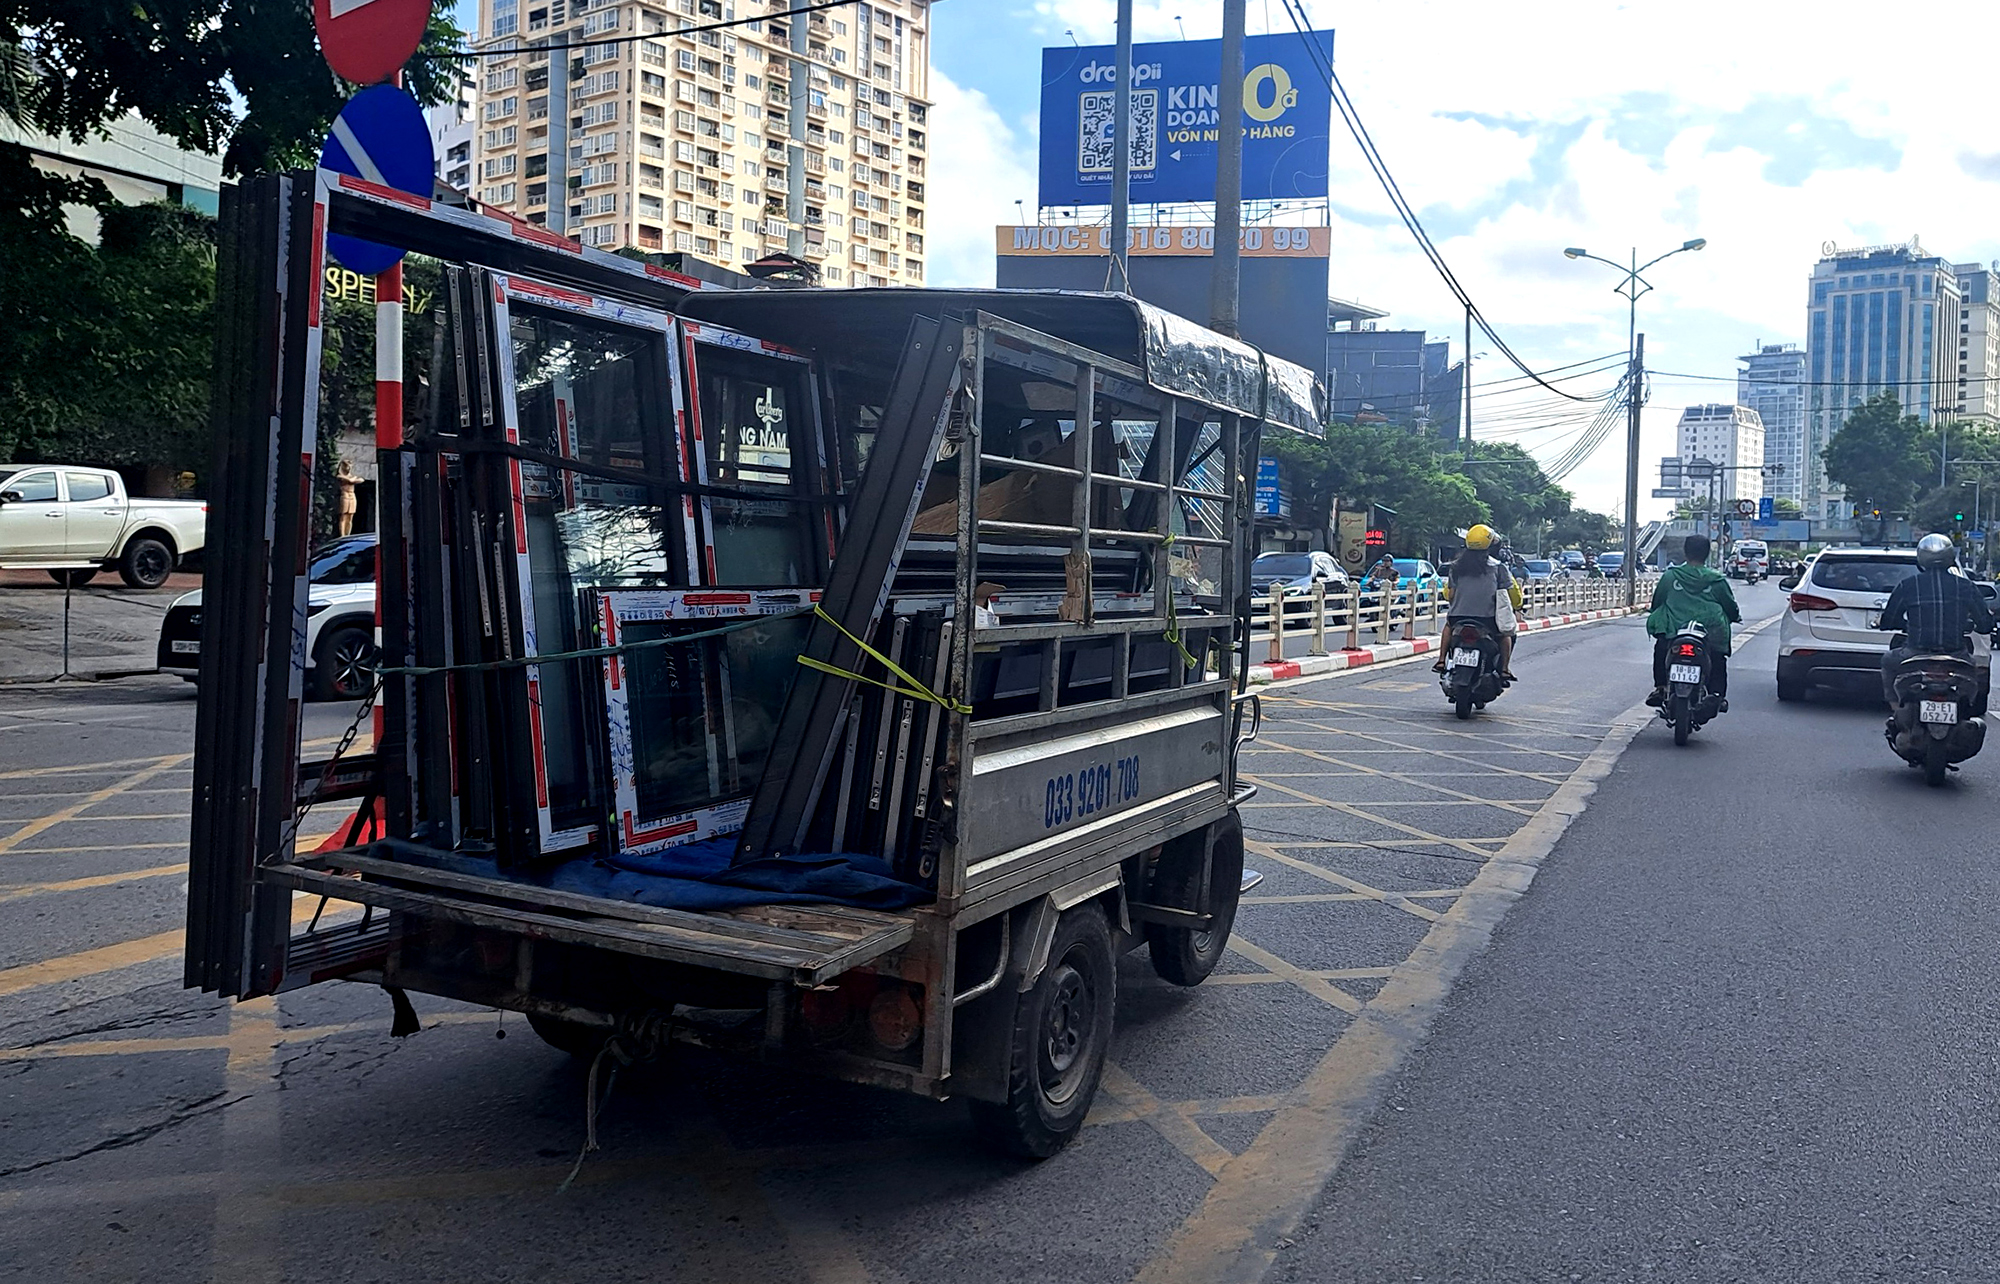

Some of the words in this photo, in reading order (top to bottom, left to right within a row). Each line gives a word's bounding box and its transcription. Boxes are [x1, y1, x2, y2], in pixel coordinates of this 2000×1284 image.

[1079, 60, 1162, 87] dropii
[1167, 84, 1219, 110] KIN
[1166, 110, 1220, 127] DOAN
[1167, 126, 1201, 143] VỐN
[1250, 124, 1296, 140] HÀNG
[1013, 227, 1088, 252] MQC:
[1272, 227, 1310, 251] 99
[759, 428, 787, 449] NAM
[1922, 711, 1955, 723] 052.74
[1926, 702, 1952, 713] 29-E1
[1045, 773, 1073, 829] 033
[1077, 763, 1111, 818] 9201
[1117, 755, 1139, 804] 708
